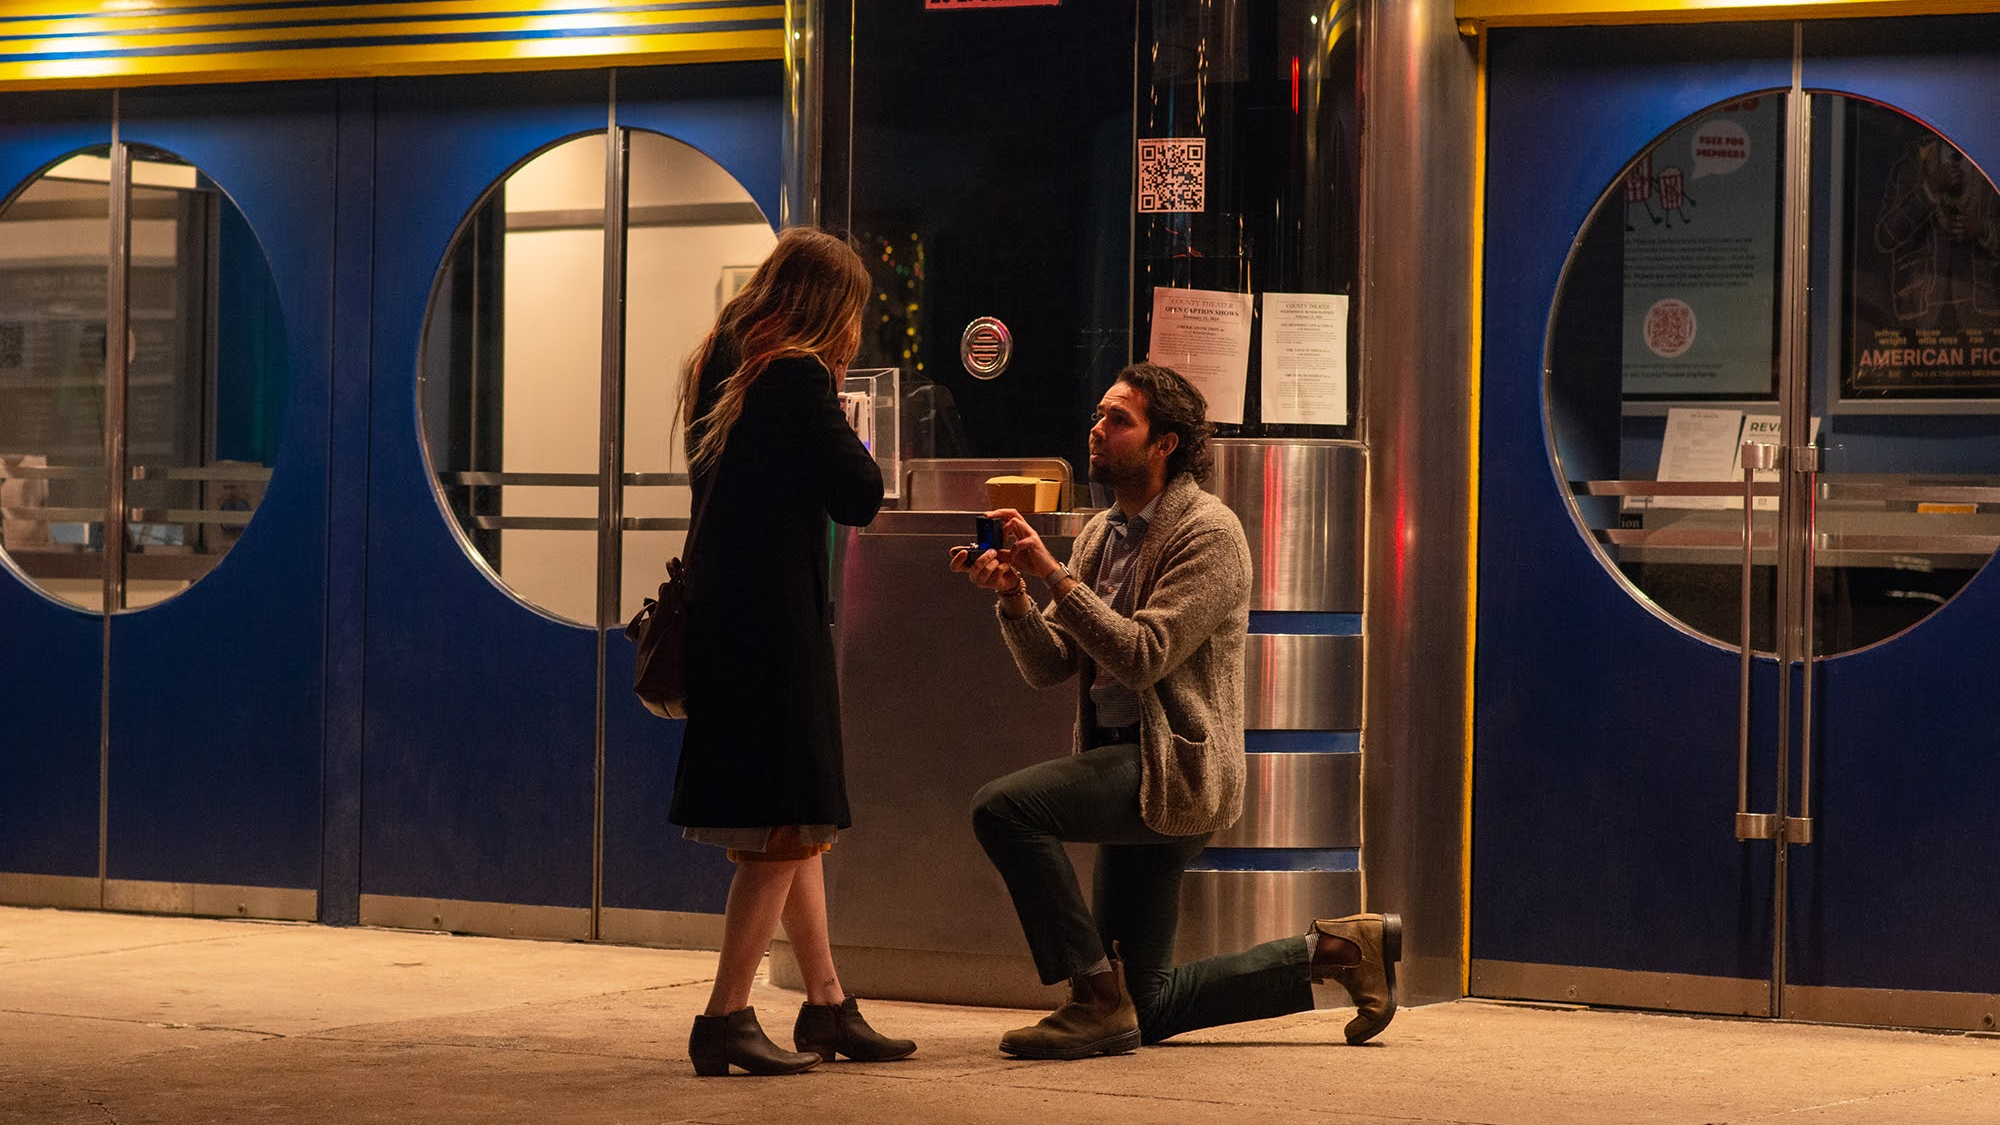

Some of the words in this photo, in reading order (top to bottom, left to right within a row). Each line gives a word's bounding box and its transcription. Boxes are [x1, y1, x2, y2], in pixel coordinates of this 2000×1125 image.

[1696, 148, 1745, 158] MEMBERS
[1202, 300, 1234, 308] THEATER
[1184, 307, 1214, 315] CAPTION
[1860, 348, 1964, 367] AMERICAN
[1970, 348, 2000, 366] FIC
